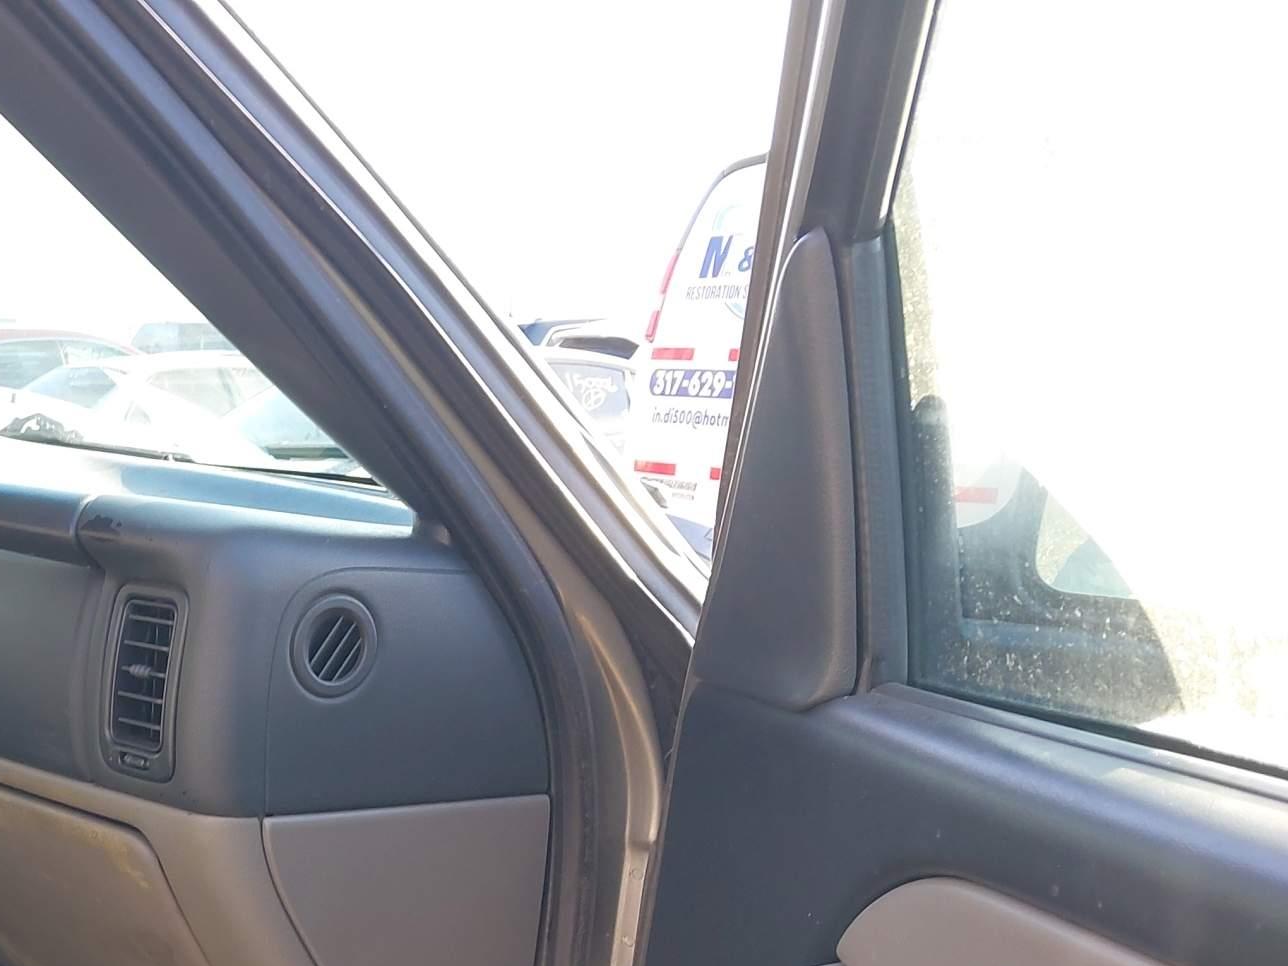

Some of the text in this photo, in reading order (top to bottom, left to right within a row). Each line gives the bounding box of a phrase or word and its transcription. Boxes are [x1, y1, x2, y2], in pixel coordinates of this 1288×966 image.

[699, 235, 733, 278] N
[686, 284, 740, 301] RESTORATION
[652, 370, 736, 397] 317-629-
